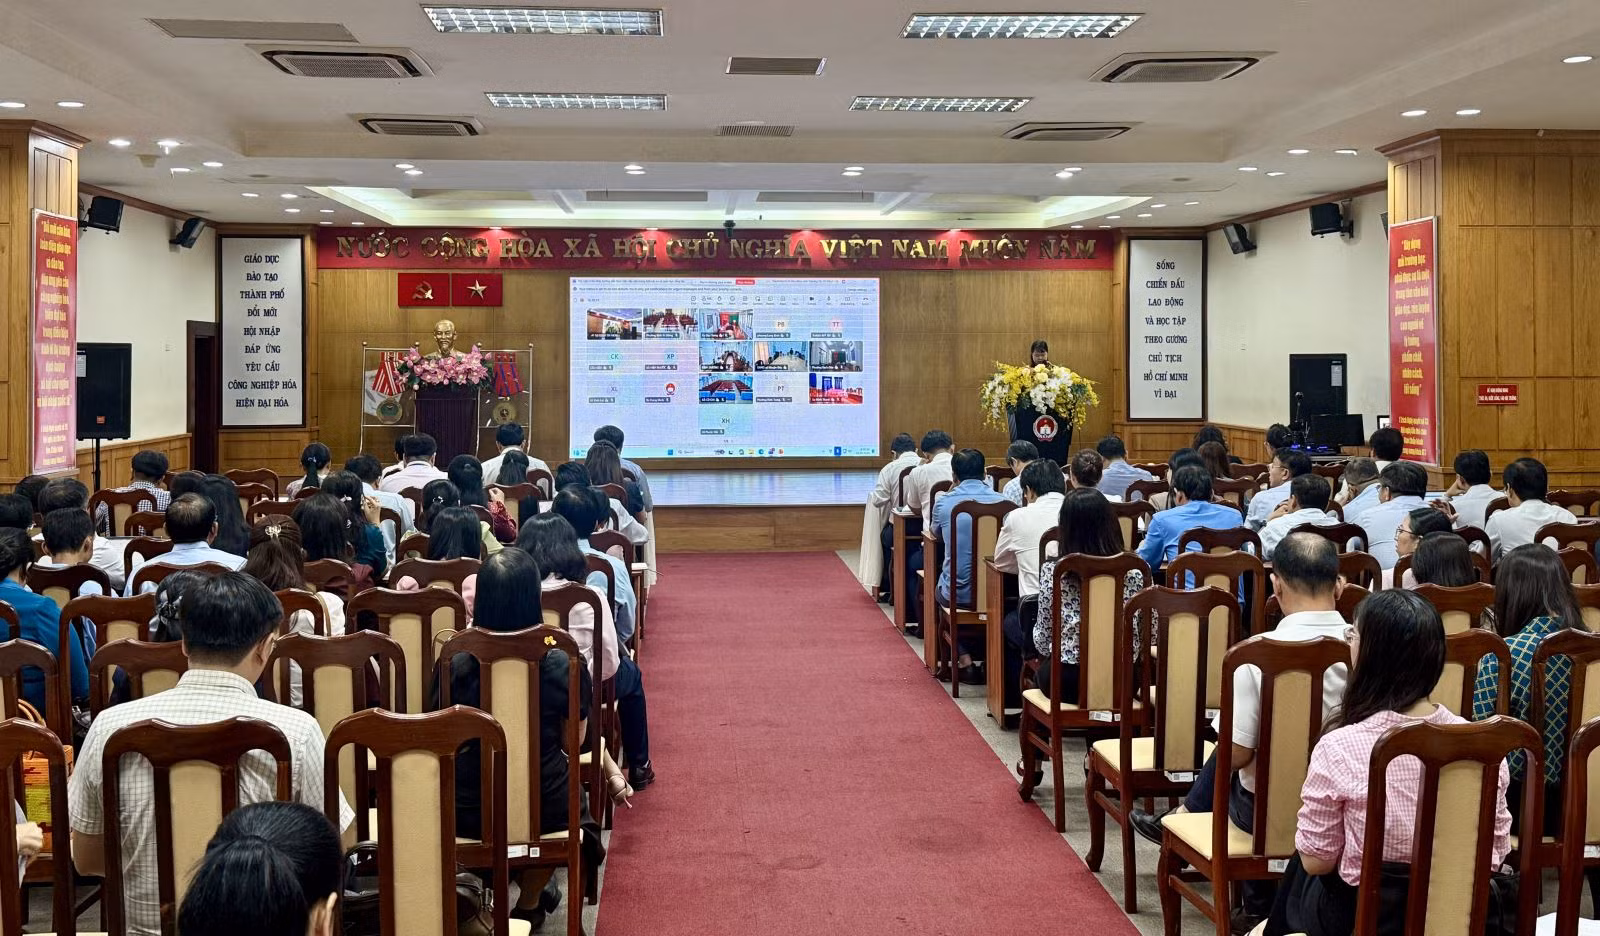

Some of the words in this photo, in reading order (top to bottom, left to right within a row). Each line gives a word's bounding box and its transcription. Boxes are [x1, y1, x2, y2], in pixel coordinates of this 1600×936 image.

[336, 228, 410, 259] NƯỚC
[421, 231, 490, 262] CỘNG
[499, 230, 553, 259] HÒA
[563, 233, 603, 259] XÃ
[613, 233, 657, 265] HỘI
[666, 231, 718, 259] CHỦ
[729, 233, 811, 260] NGHĨA
[819, 233, 883, 262] VIỆT
[891, 238, 949, 259] NAM
[959, 232, 1030, 259] MUÔN
[1039, 233, 1097, 260] NĂM
[244, 254, 262, 264] GIÁO
[265, 255, 279, 265] DỤC
[1156, 259, 1175, 270] SỐNG
[246, 271, 261, 281] ĐÀO
[264, 273, 278, 282] TẠO
[1146, 278, 1167, 289] CHIẾN
[1170, 278, 1185, 289] ĐẤU
[240, 289, 266, 299] THÀNH
[270, 287, 285, 299] PHỐ
[1148, 299, 1161, 307] LAO
[1165, 297, 1184, 308] ĐỘNG
[247, 304, 260, 317] ĐỔI
[264, 306, 277, 317] MỚI
[1145, 315, 1154, 326] VÀ
[1156, 318, 1170, 327] HỌC
[1172, 316, 1186, 327] TẬP
[244, 325, 257, 337] HỘI
[259, 325, 280, 337] NHẬP
[1144, 336, 1163, 344] THEO
[1165, 335, 1187, 344] GƯƠNG
[245, 343, 260, 354] ĐÁP
[266, 343, 280, 354] ỨNG
[1148, 351, 1163, 363] CHỦ
[1165, 354, 1182, 364] TỊCH
[246, 362, 261, 372] YÊU
[265, 359, 280, 372] CẦU
[1144, 369, 1153, 381] HỒ
[1155, 370, 1167, 381] CHÍ
[1170, 373, 1188, 381] MINH
[228, 379, 247, 390] CÔNG
[251, 380, 279, 391] NGHIỆP
[282, 379, 297, 390] HÓA
[1164, 390, 1177, 399] ĐẠI
[236, 398, 254, 409] HIỆN
[258, 399, 271, 409] ĐẠI
[274, 397, 289, 408] HÓA
